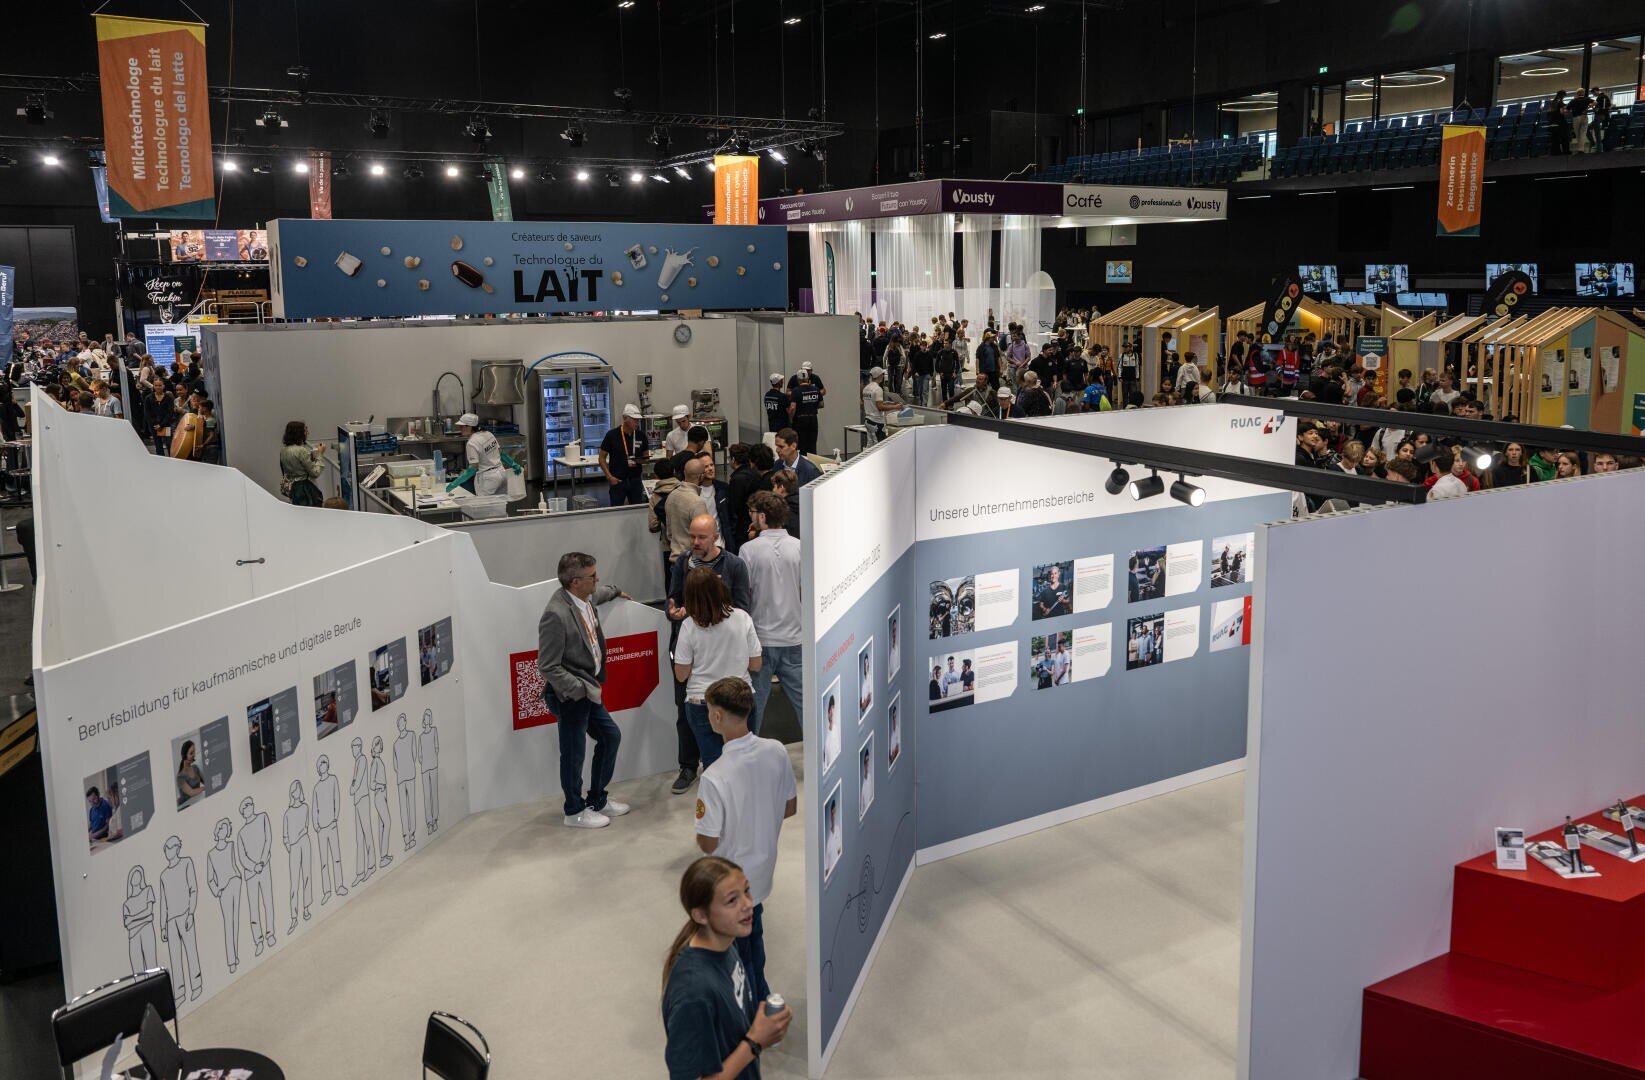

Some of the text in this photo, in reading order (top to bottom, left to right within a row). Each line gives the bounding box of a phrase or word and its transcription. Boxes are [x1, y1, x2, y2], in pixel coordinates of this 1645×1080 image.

[127, 57, 146, 180] Milchtechnologe
[148, 47, 170, 192] Technologue du lait
[172, 51, 192, 190] Tecnologo del latte
[1446, 156, 1456, 207] Zeichnerin
[1457, 152, 1467, 211] Dessinatrice
[1468, 152, 1478, 212] Disegnatrice
[952, 188, 995, 206] Yousty
[1066, 194, 1103, 208] Café
[1141, 199, 1182, 207] professional.ch
[1187, 197, 1221, 212] Yousty
[511, 232, 602, 242] Créateurs de saveurs
[513, 253, 603, 267] Technologue du
[144, 277, 170, 292] Keep
[513, 266, 603, 303] LAIT
[147, 291, 183, 305] Truckin'
[1231, 416, 1262, 429] RUAG
[930, 490, 1095, 522] Unsere Unternehmensbereiche
[606, 646, 624, 655] SEREN
[606, 649, 653, 663] DUNGSBERUFEN
[78, 617, 362, 741] Berufsbildung für kaufmännische und digitale Berufe
